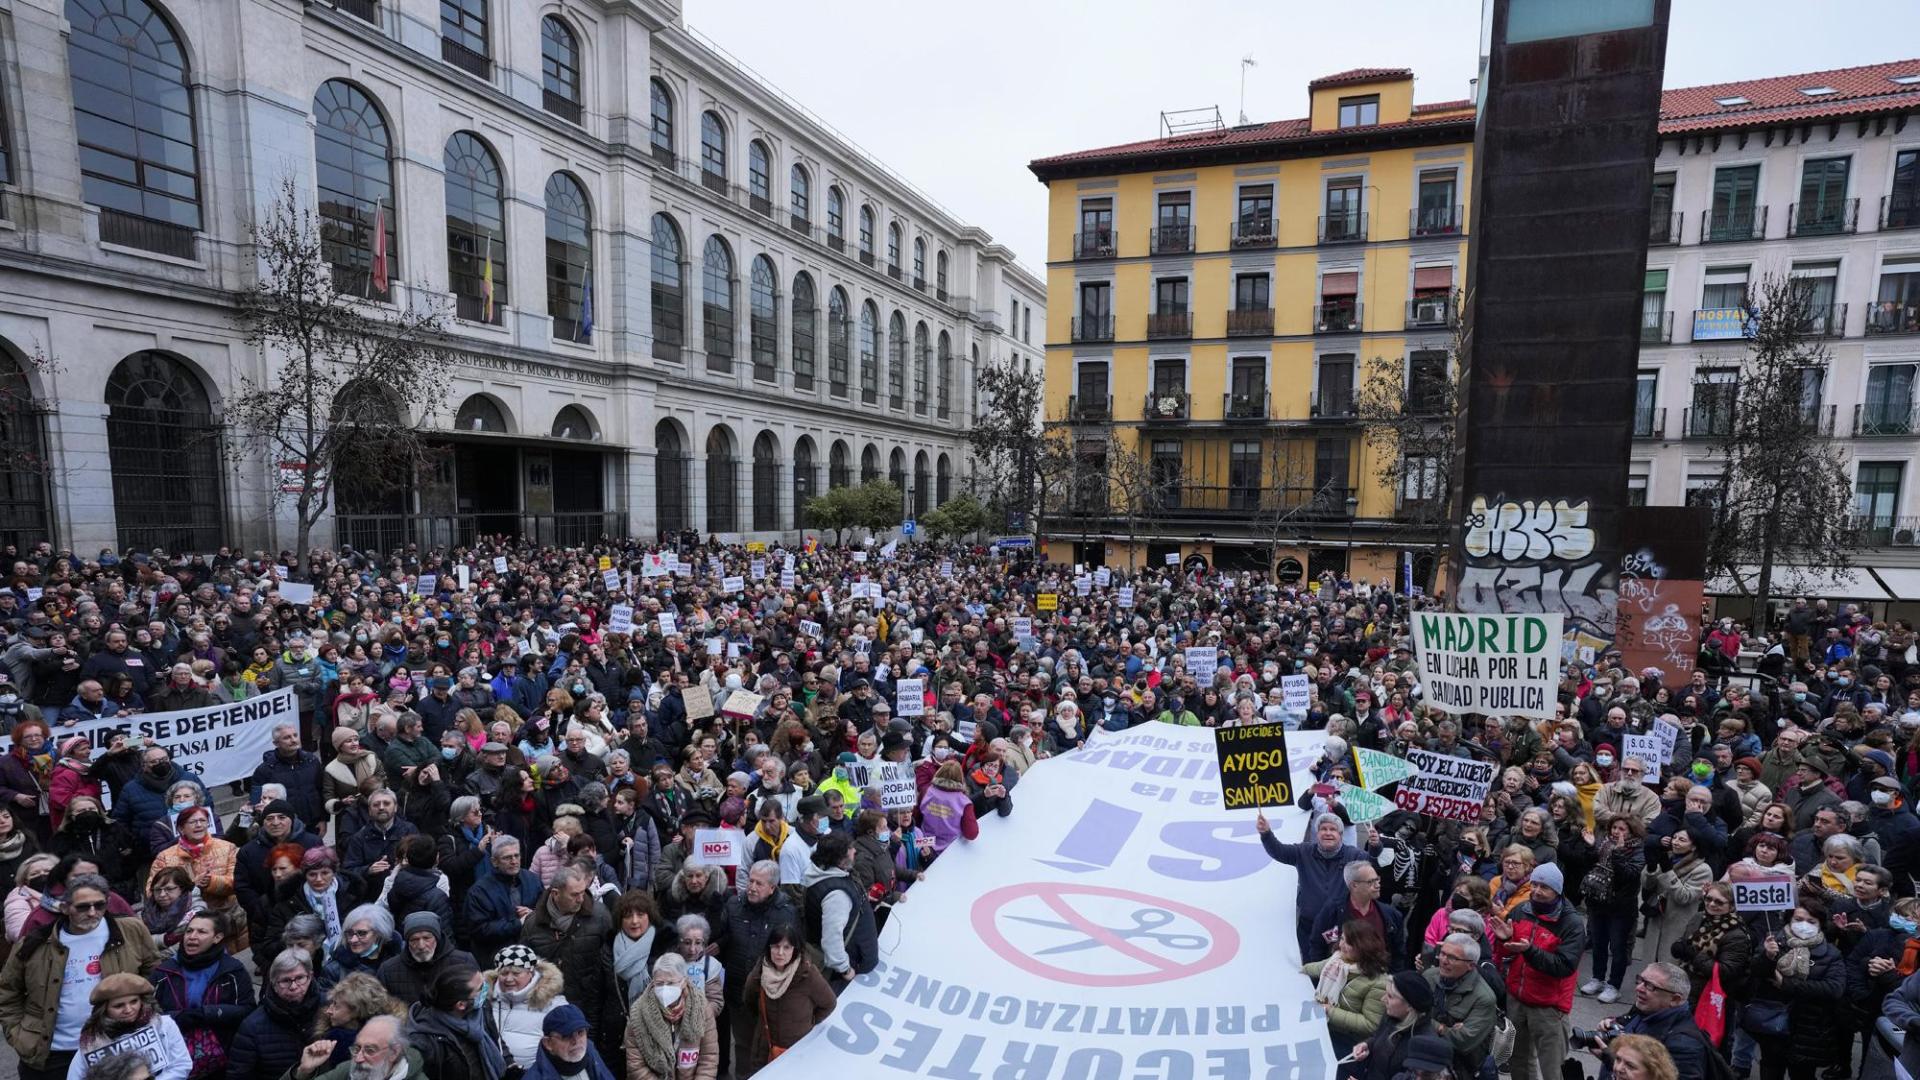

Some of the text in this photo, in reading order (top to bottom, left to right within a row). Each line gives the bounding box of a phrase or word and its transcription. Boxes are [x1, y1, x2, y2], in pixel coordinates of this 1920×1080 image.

[459, 353, 508, 371] SUPERIOR
[511, 361, 524, 373] DE
[563, 368, 575, 380] DE
[576, 372, 611, 387] MADRID
[1421, 615, 1547, 653] MADRID
[1426, 652, 1547, 680] EN LUCHA POR LA
[1480, 686, 1544, 710] PUBLICA
[139, 693, 292, 739] SE DEFIENDE!
[216, 733, 234, 750] DE
[1220, 730, 1234, 742] TU
[1223, 749, 1283, 773] AYUSO
[1360, 750, 1404, 768] SANIDAD
[1435, 759, 1454, 776] EL
[1454, 762, 1493, 783] NUEVO
[1225, 782, 1289, 806] SANIDAD
[1427, 778, 1471, 798] URGENCIAS
[1395, 789, 1481, 821] OS ESPERO
[1736, 883, 1791, 904] Basta!
[856, 961, 1280, 1036] PRIVATIZACIONES
[110, 1029, 156, 1057] VENDE
